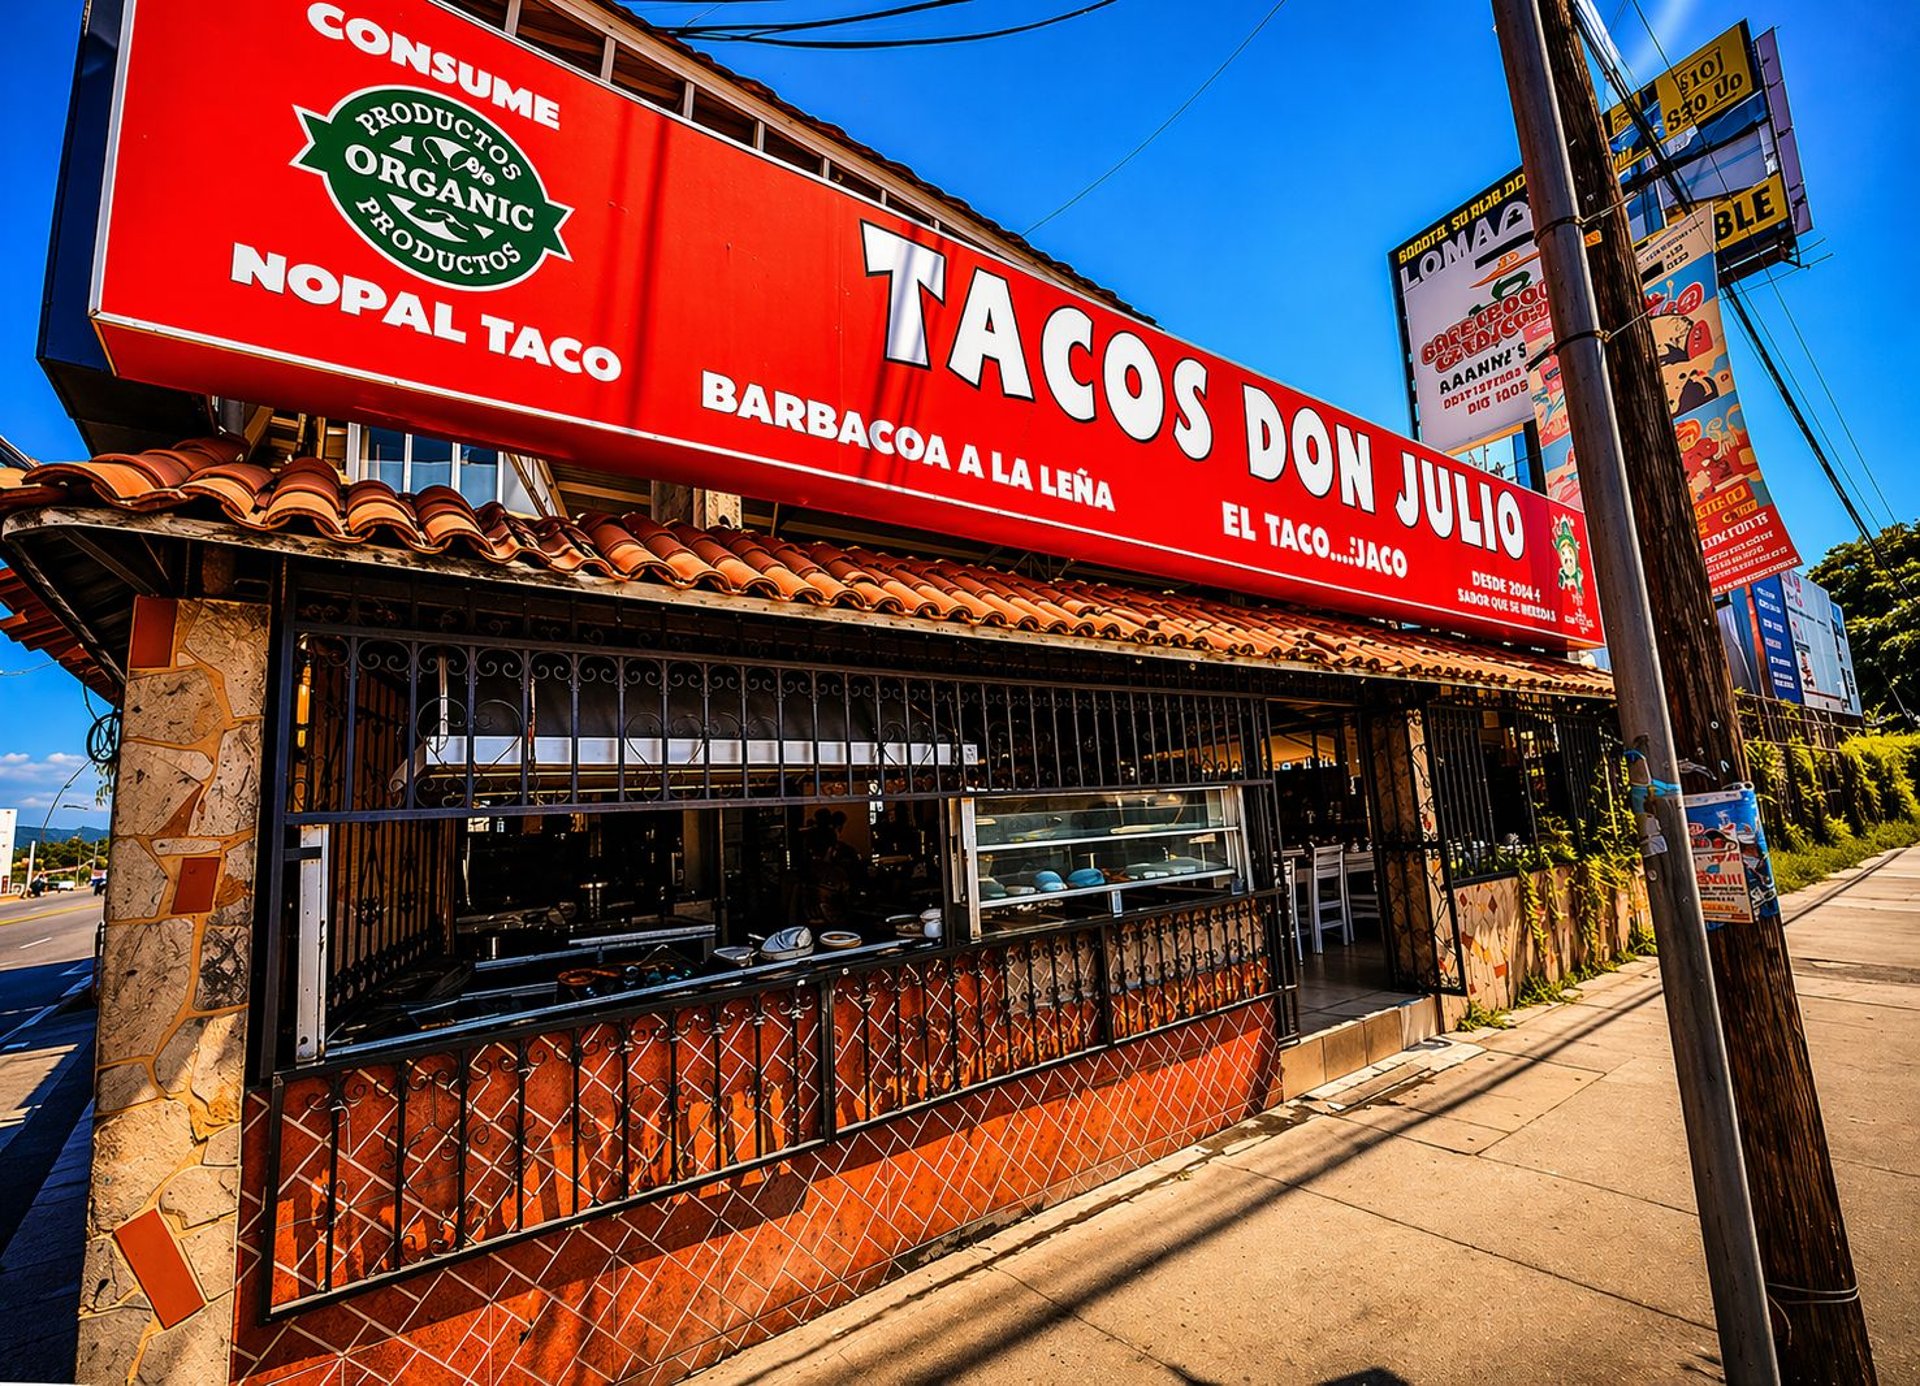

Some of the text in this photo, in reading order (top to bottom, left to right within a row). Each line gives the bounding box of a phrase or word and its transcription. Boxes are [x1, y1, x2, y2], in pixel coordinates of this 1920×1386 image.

[307, 2, 560, 131] CONSUME
[354, 102, 522, 182] PRODUCTOS
[344, 143, 534, 232] ORGANIC
[355, 196, 522, 276] PRODUCTOS
[230, 242, 622, 382] NOPAL TACO
[860, 219, 1525, 560] TACOS DON JULIO
[702, 370, 1116, 512] BARBACOA A LA LEÑA
[1221, 500, 1257, 542] EL
[1471, 570, 1507, 593] DESDE
[1490, 596, 1509, 612] QUE
